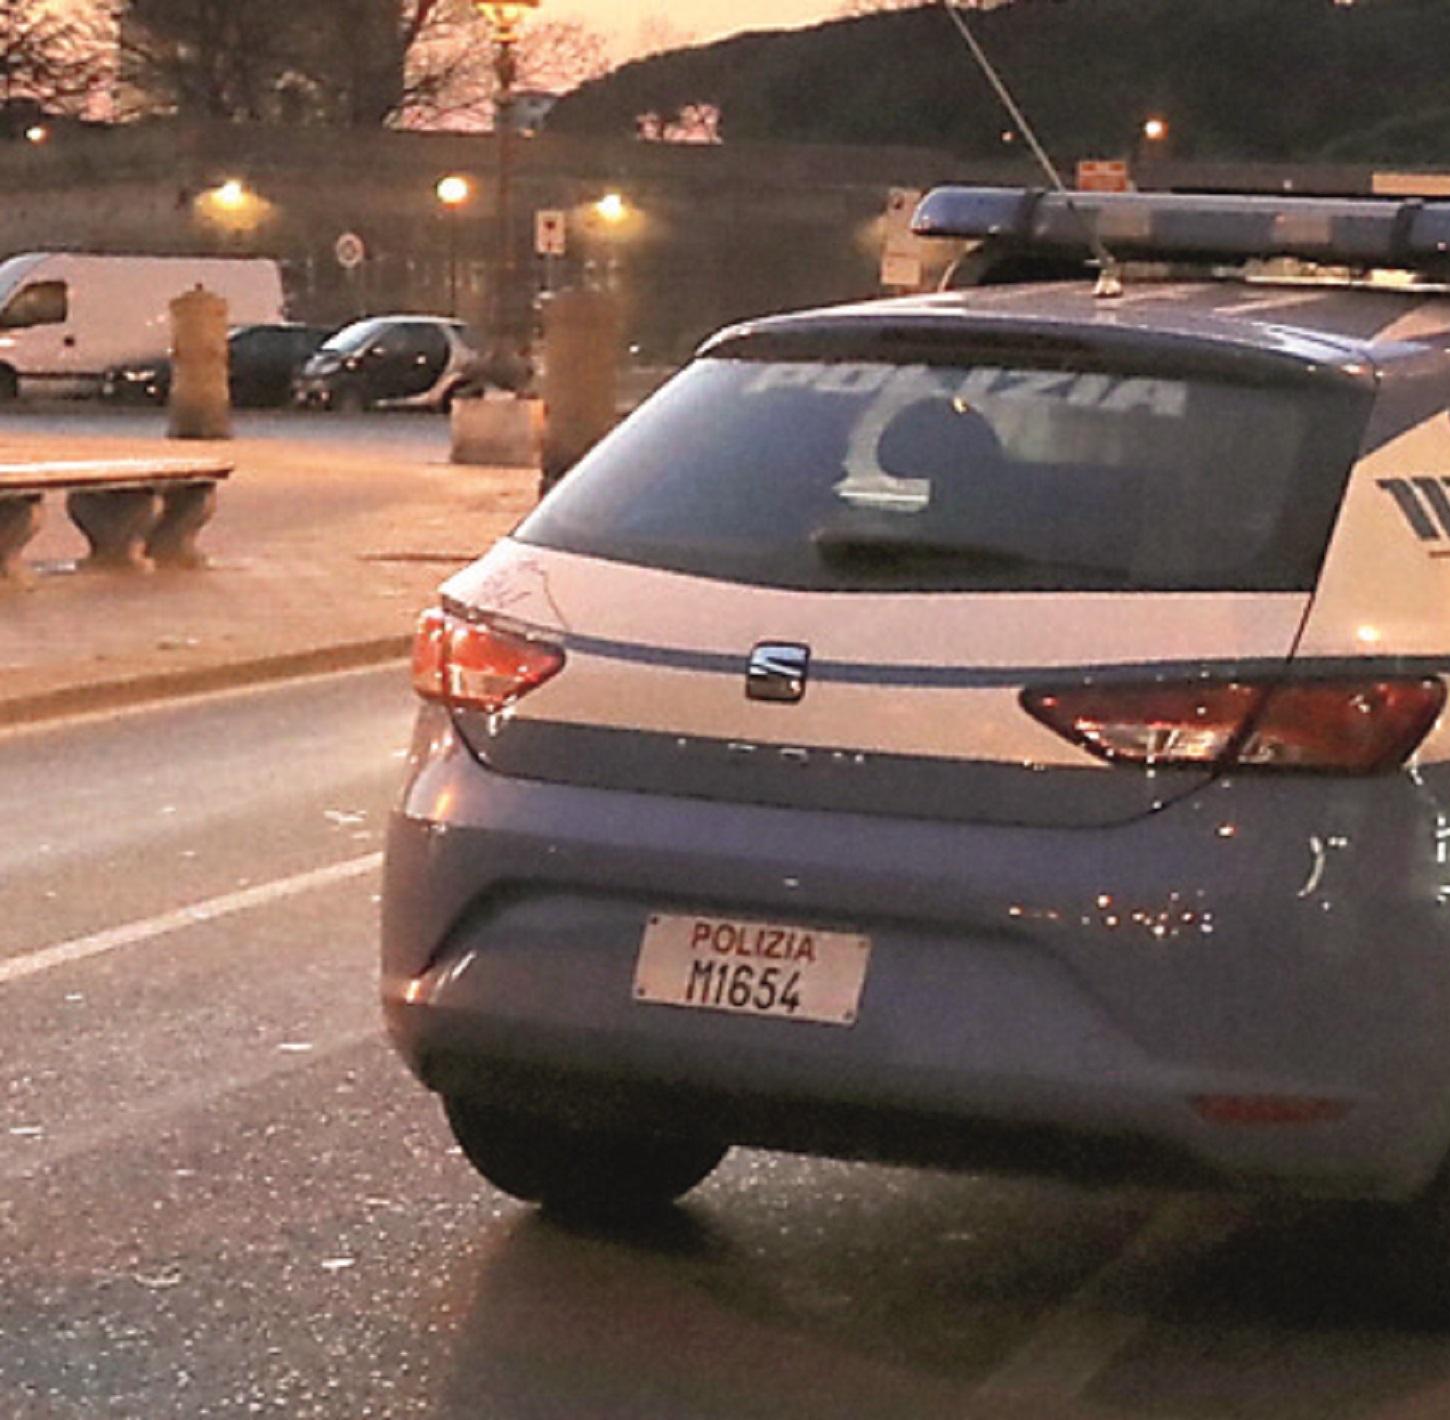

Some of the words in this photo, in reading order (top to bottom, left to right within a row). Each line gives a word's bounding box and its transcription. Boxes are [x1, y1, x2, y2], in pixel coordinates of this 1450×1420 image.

[743, 361, 1189, 416] POLIZIA
[692, 922, 817, 963] POLIZIA
[685, 959, 802, 1014] M1654
